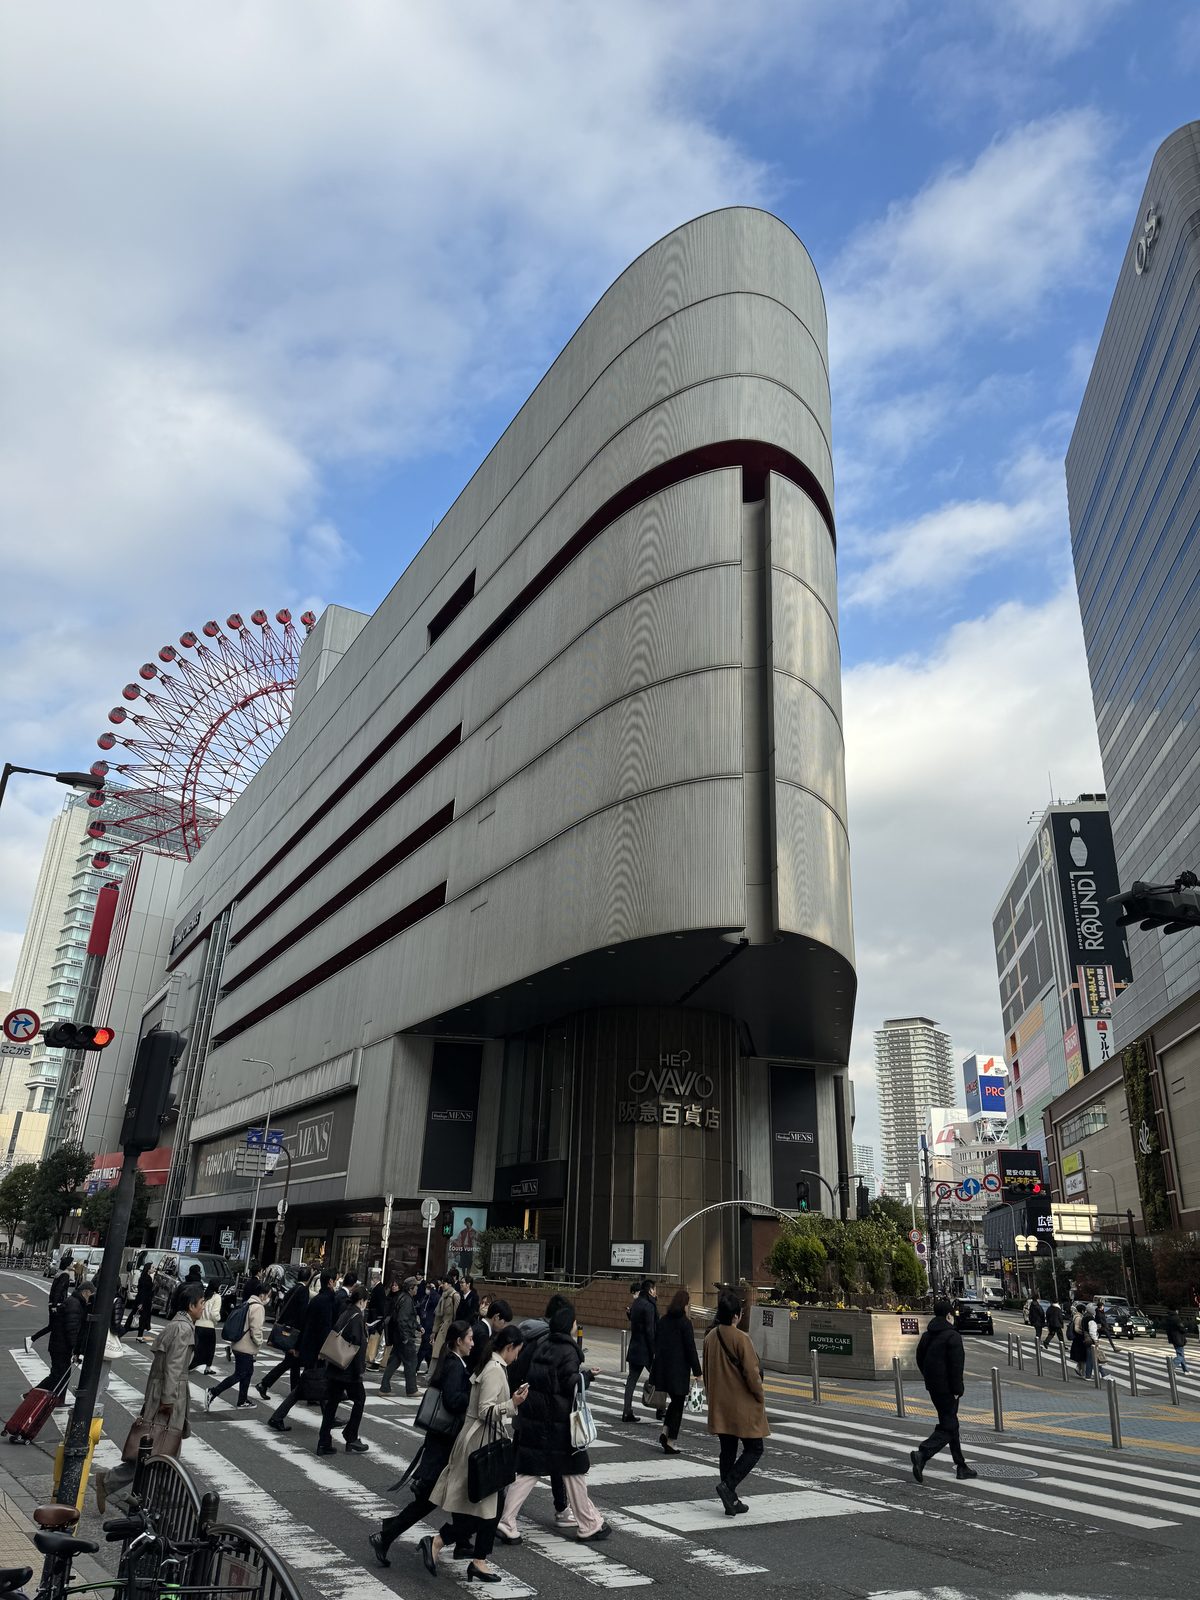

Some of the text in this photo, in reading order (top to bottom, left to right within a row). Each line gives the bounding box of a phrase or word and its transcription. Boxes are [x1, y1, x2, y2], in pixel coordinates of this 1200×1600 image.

[1070, 880, 1081, 928] ENTERTAINMENT
[1, 1046, 31, 1056] ここから
[1099, 1032, 1110, 1061] マルハ
[618, 1102, 721, 1129] 阪急百貨店
[223, 1148, 240, 1172] CINE
[810, 1335, 834, 1343] FLOWER
